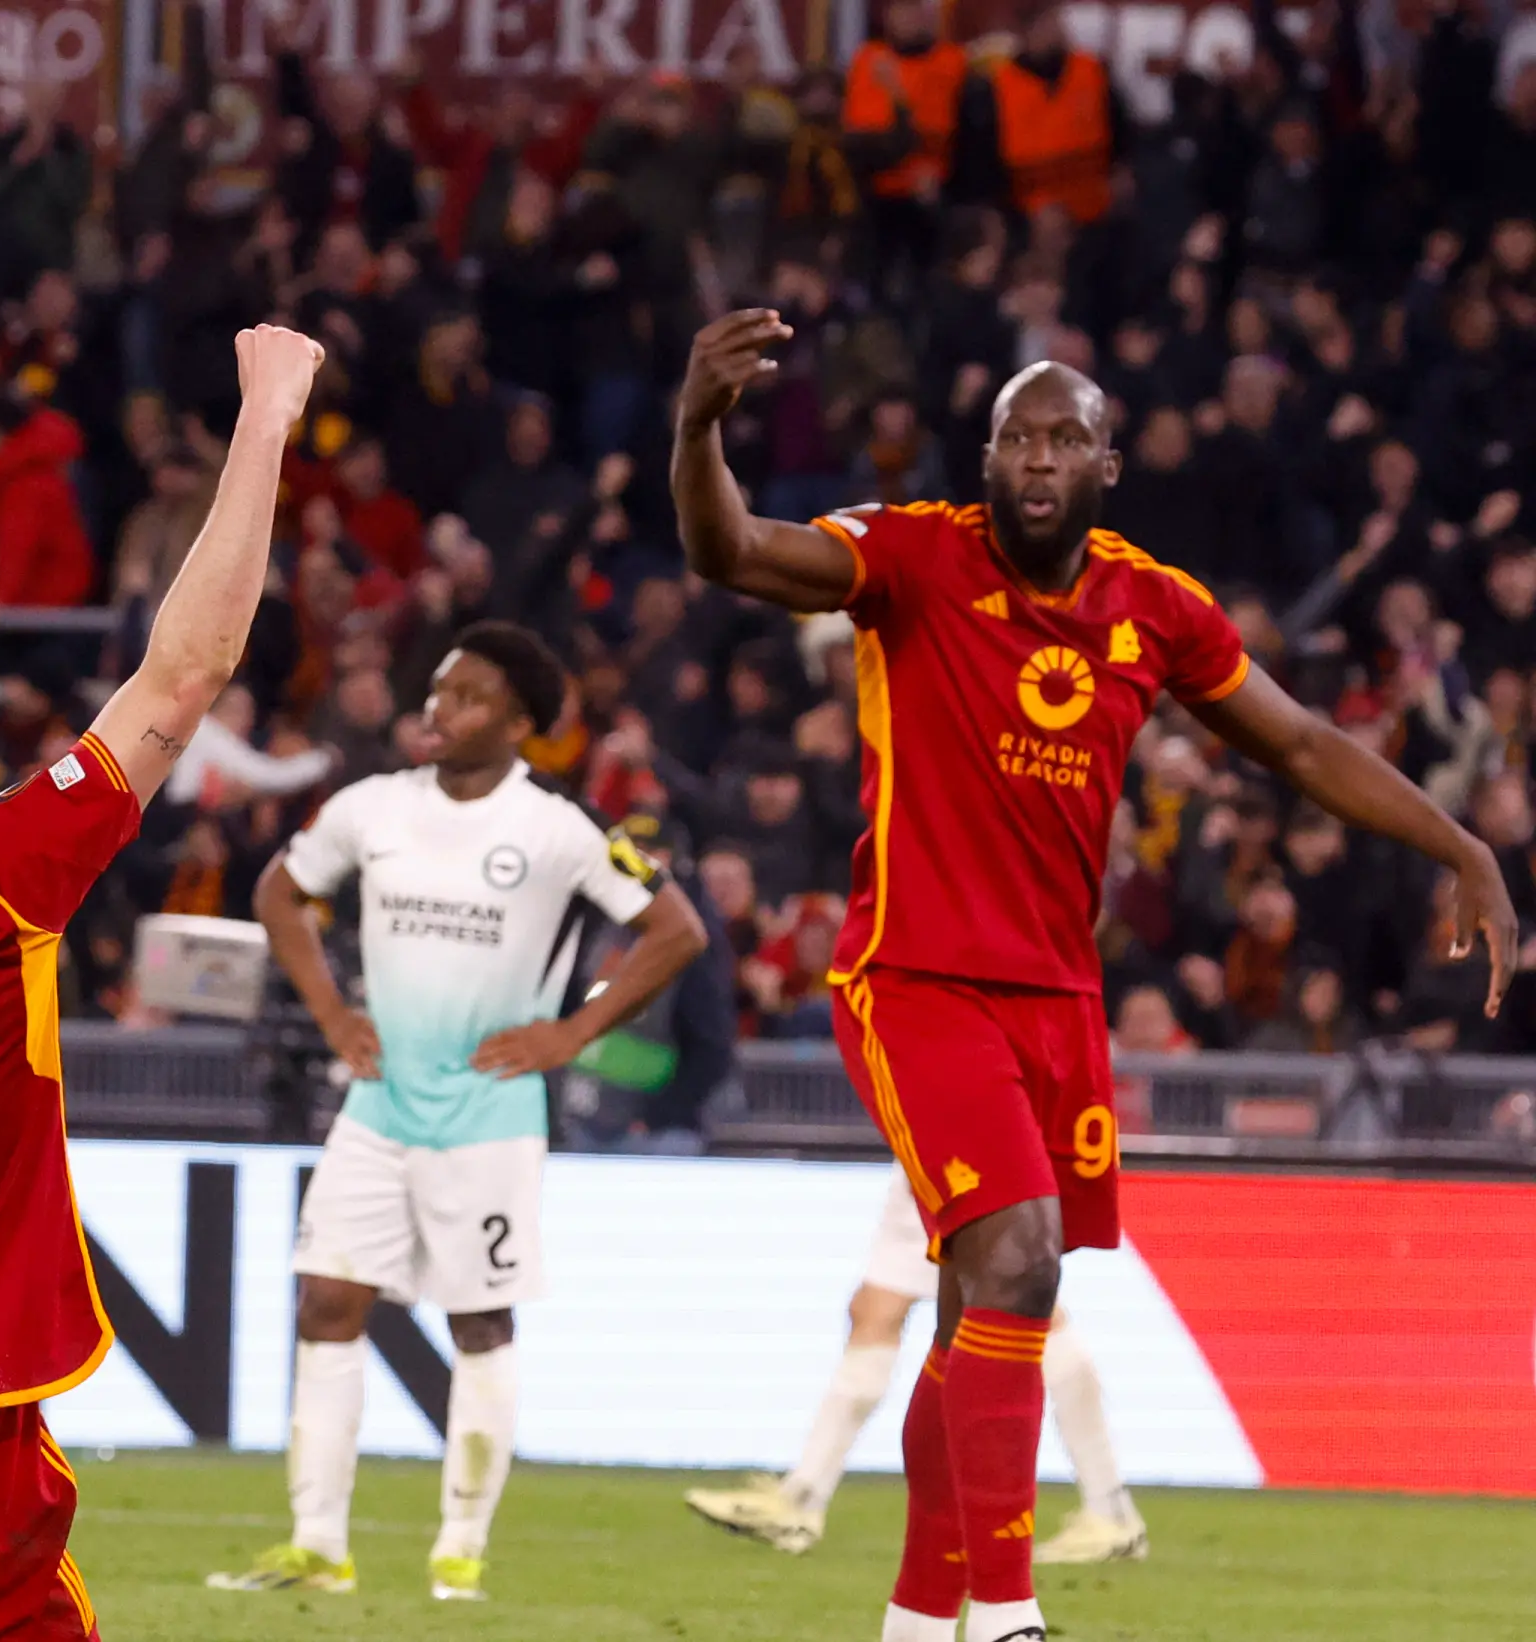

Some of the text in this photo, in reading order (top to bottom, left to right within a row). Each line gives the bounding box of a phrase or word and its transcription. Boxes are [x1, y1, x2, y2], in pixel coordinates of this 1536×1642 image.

[997, 753, 1088, 789] SEASON
[998, 731, 1092, 768] RIYADH
[1073, 1104, 1120, 1179] 9
[482, 1213, 518, 1270] 2
